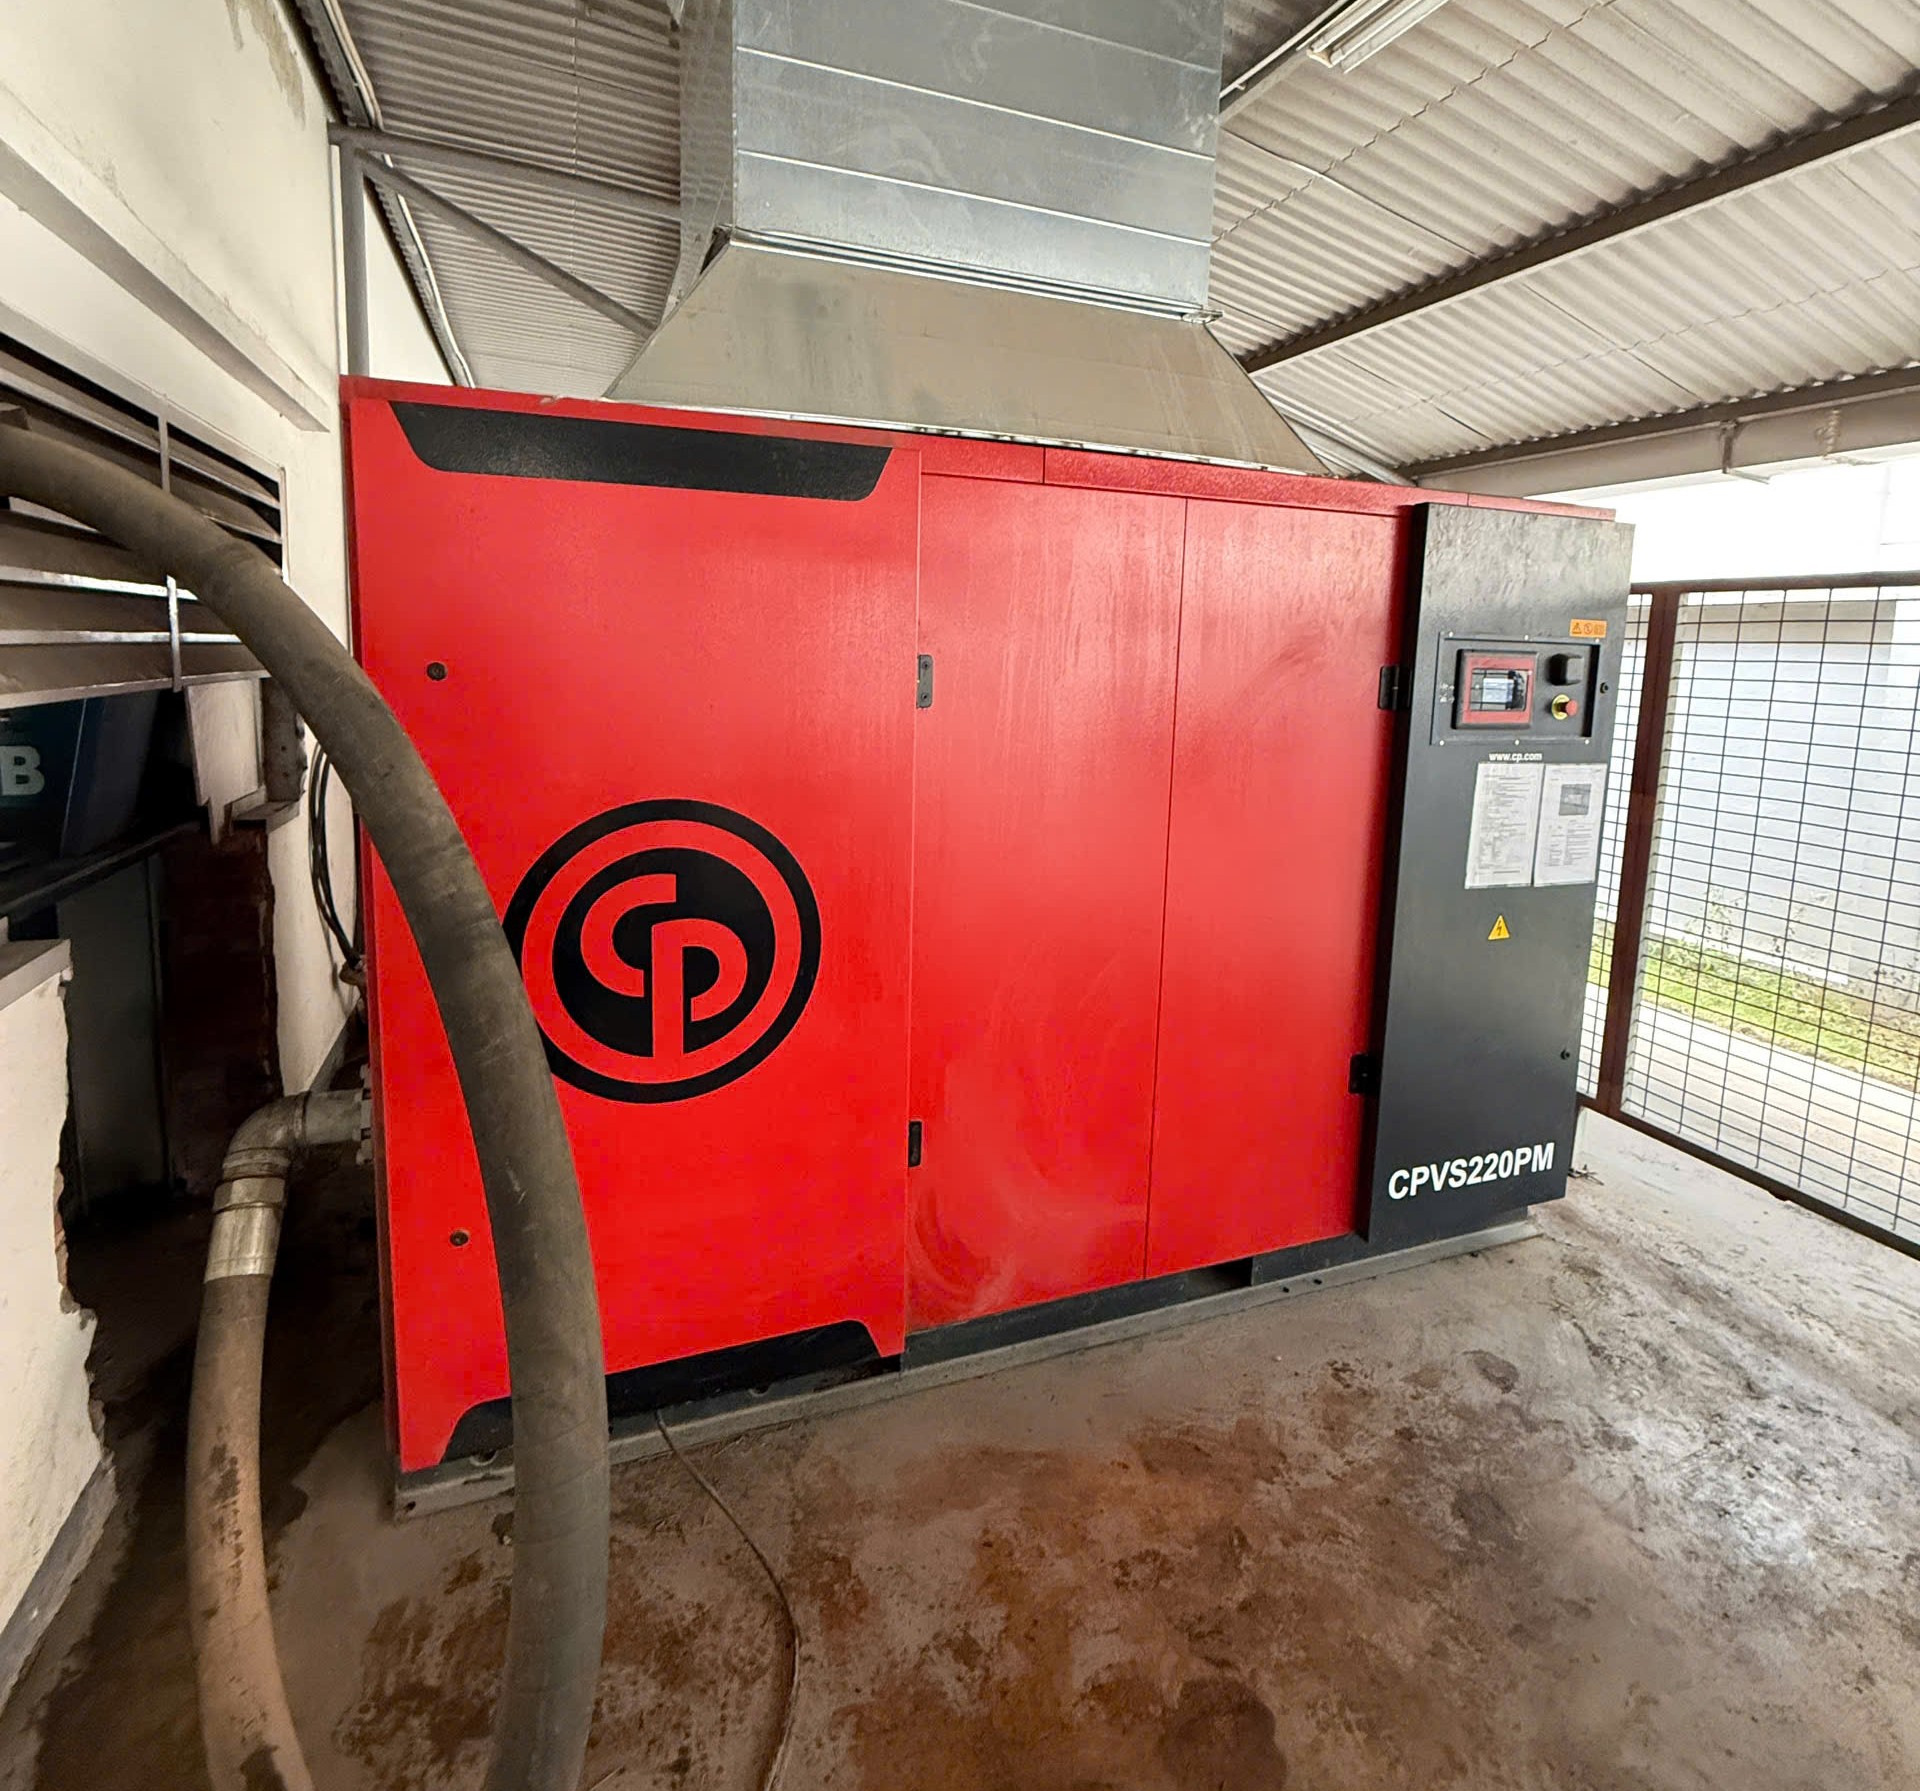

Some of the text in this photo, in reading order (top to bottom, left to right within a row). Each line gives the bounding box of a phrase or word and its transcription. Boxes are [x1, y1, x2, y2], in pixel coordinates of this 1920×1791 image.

[0, 745, 45, 796] B
[1489, 752, 1542, 764] www.cp.com
[580, 873, 748, 1058] CP
[1388, 1142, 1555, 1200] CPVS220PM
